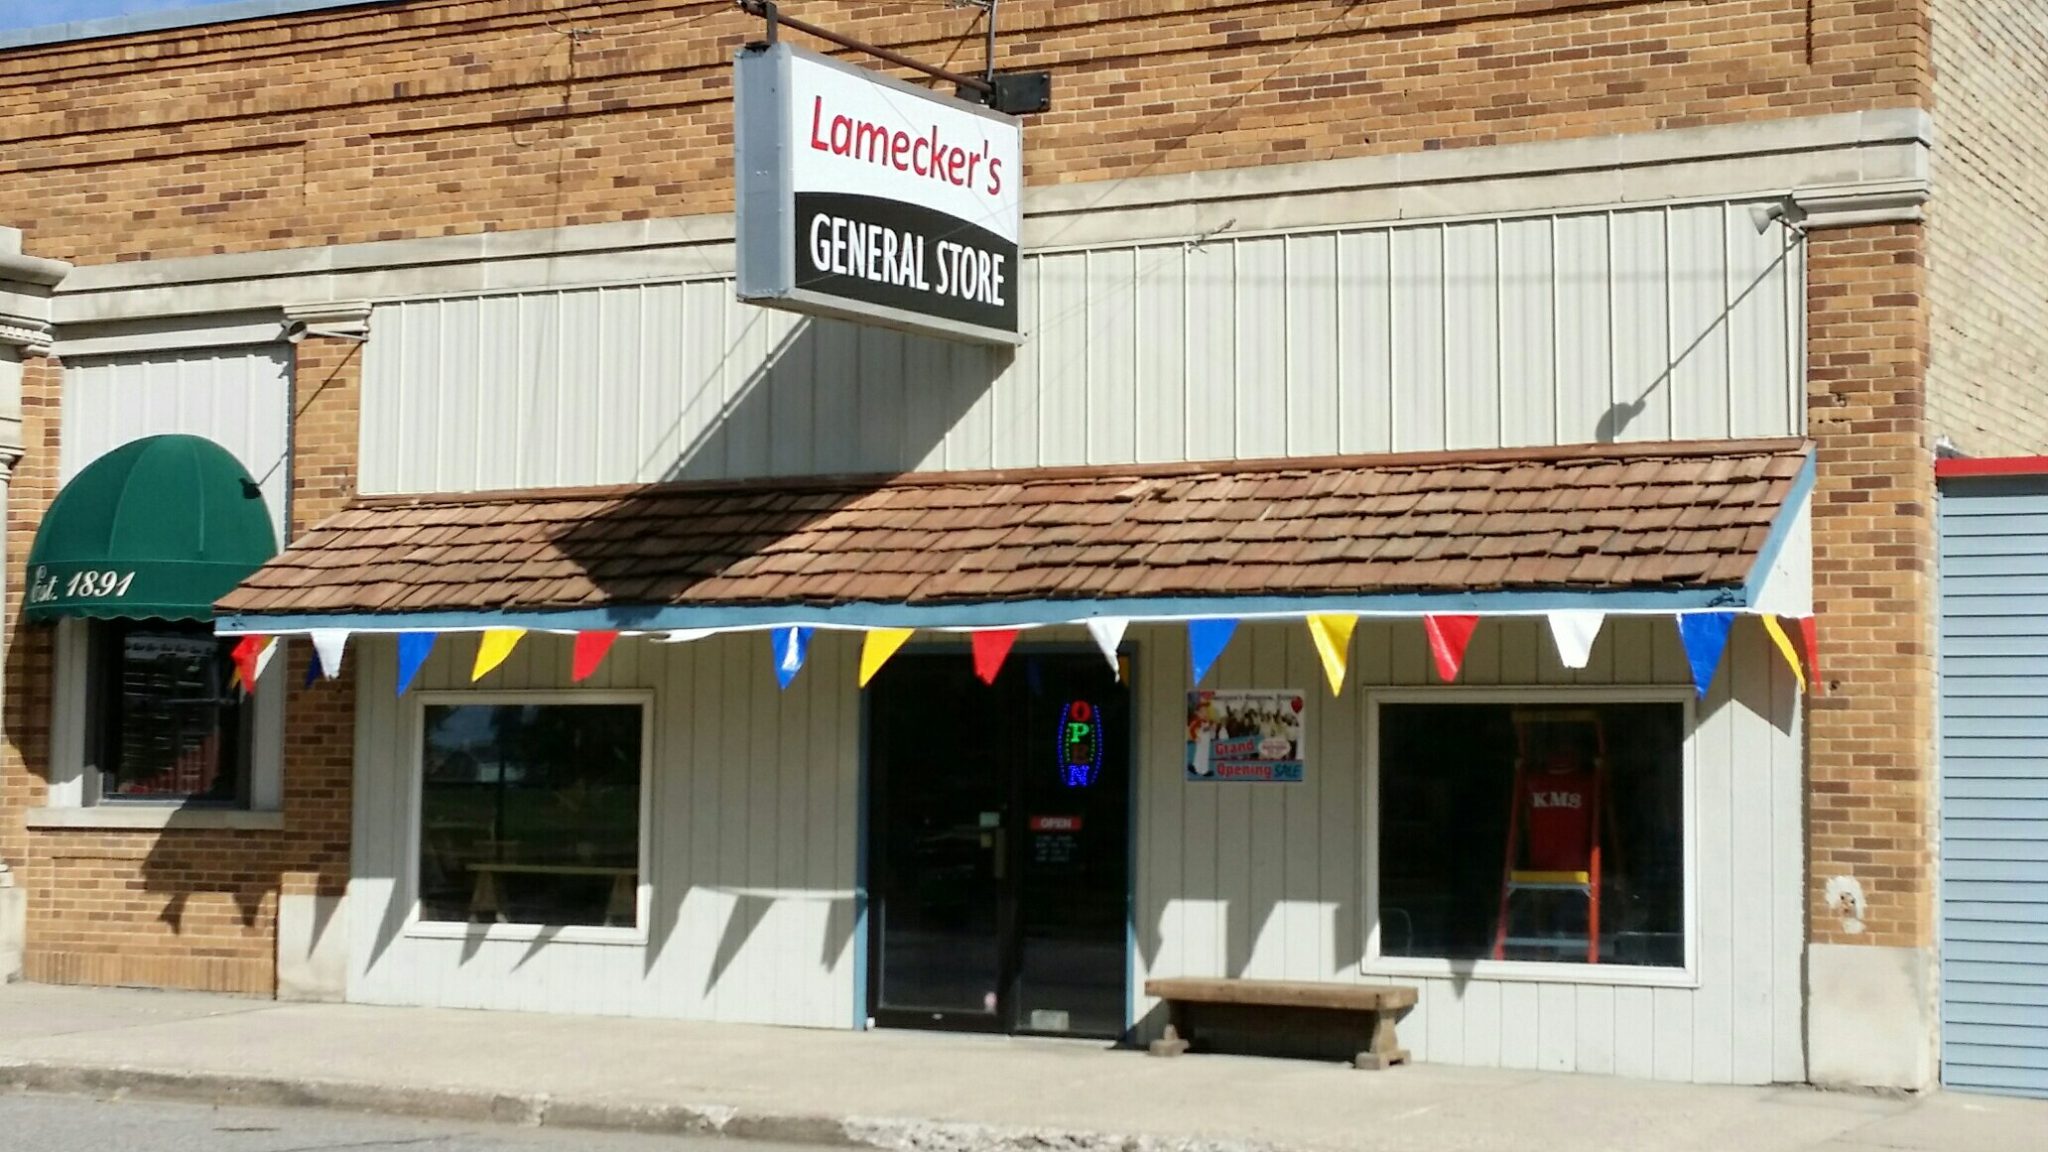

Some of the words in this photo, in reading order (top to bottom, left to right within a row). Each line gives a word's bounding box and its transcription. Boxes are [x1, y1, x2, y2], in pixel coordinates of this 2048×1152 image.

[810, 95, 1002, 196] Lamecker's
[810, 212, 930, 291] GENERAL
[935, 241, 1005, 307] STORE
[31, 564, 59, 602] Est.
[66, 570, 136, 597] 1891
[1067, 700, 1090, 787] OPEN
[1215, 740, 1255, 755] Grand
[1217, 762, 1272, 778] Opening
[1533, 793, 1581, 808] KMS
[1040, 817, 1072, 829] OPEN
